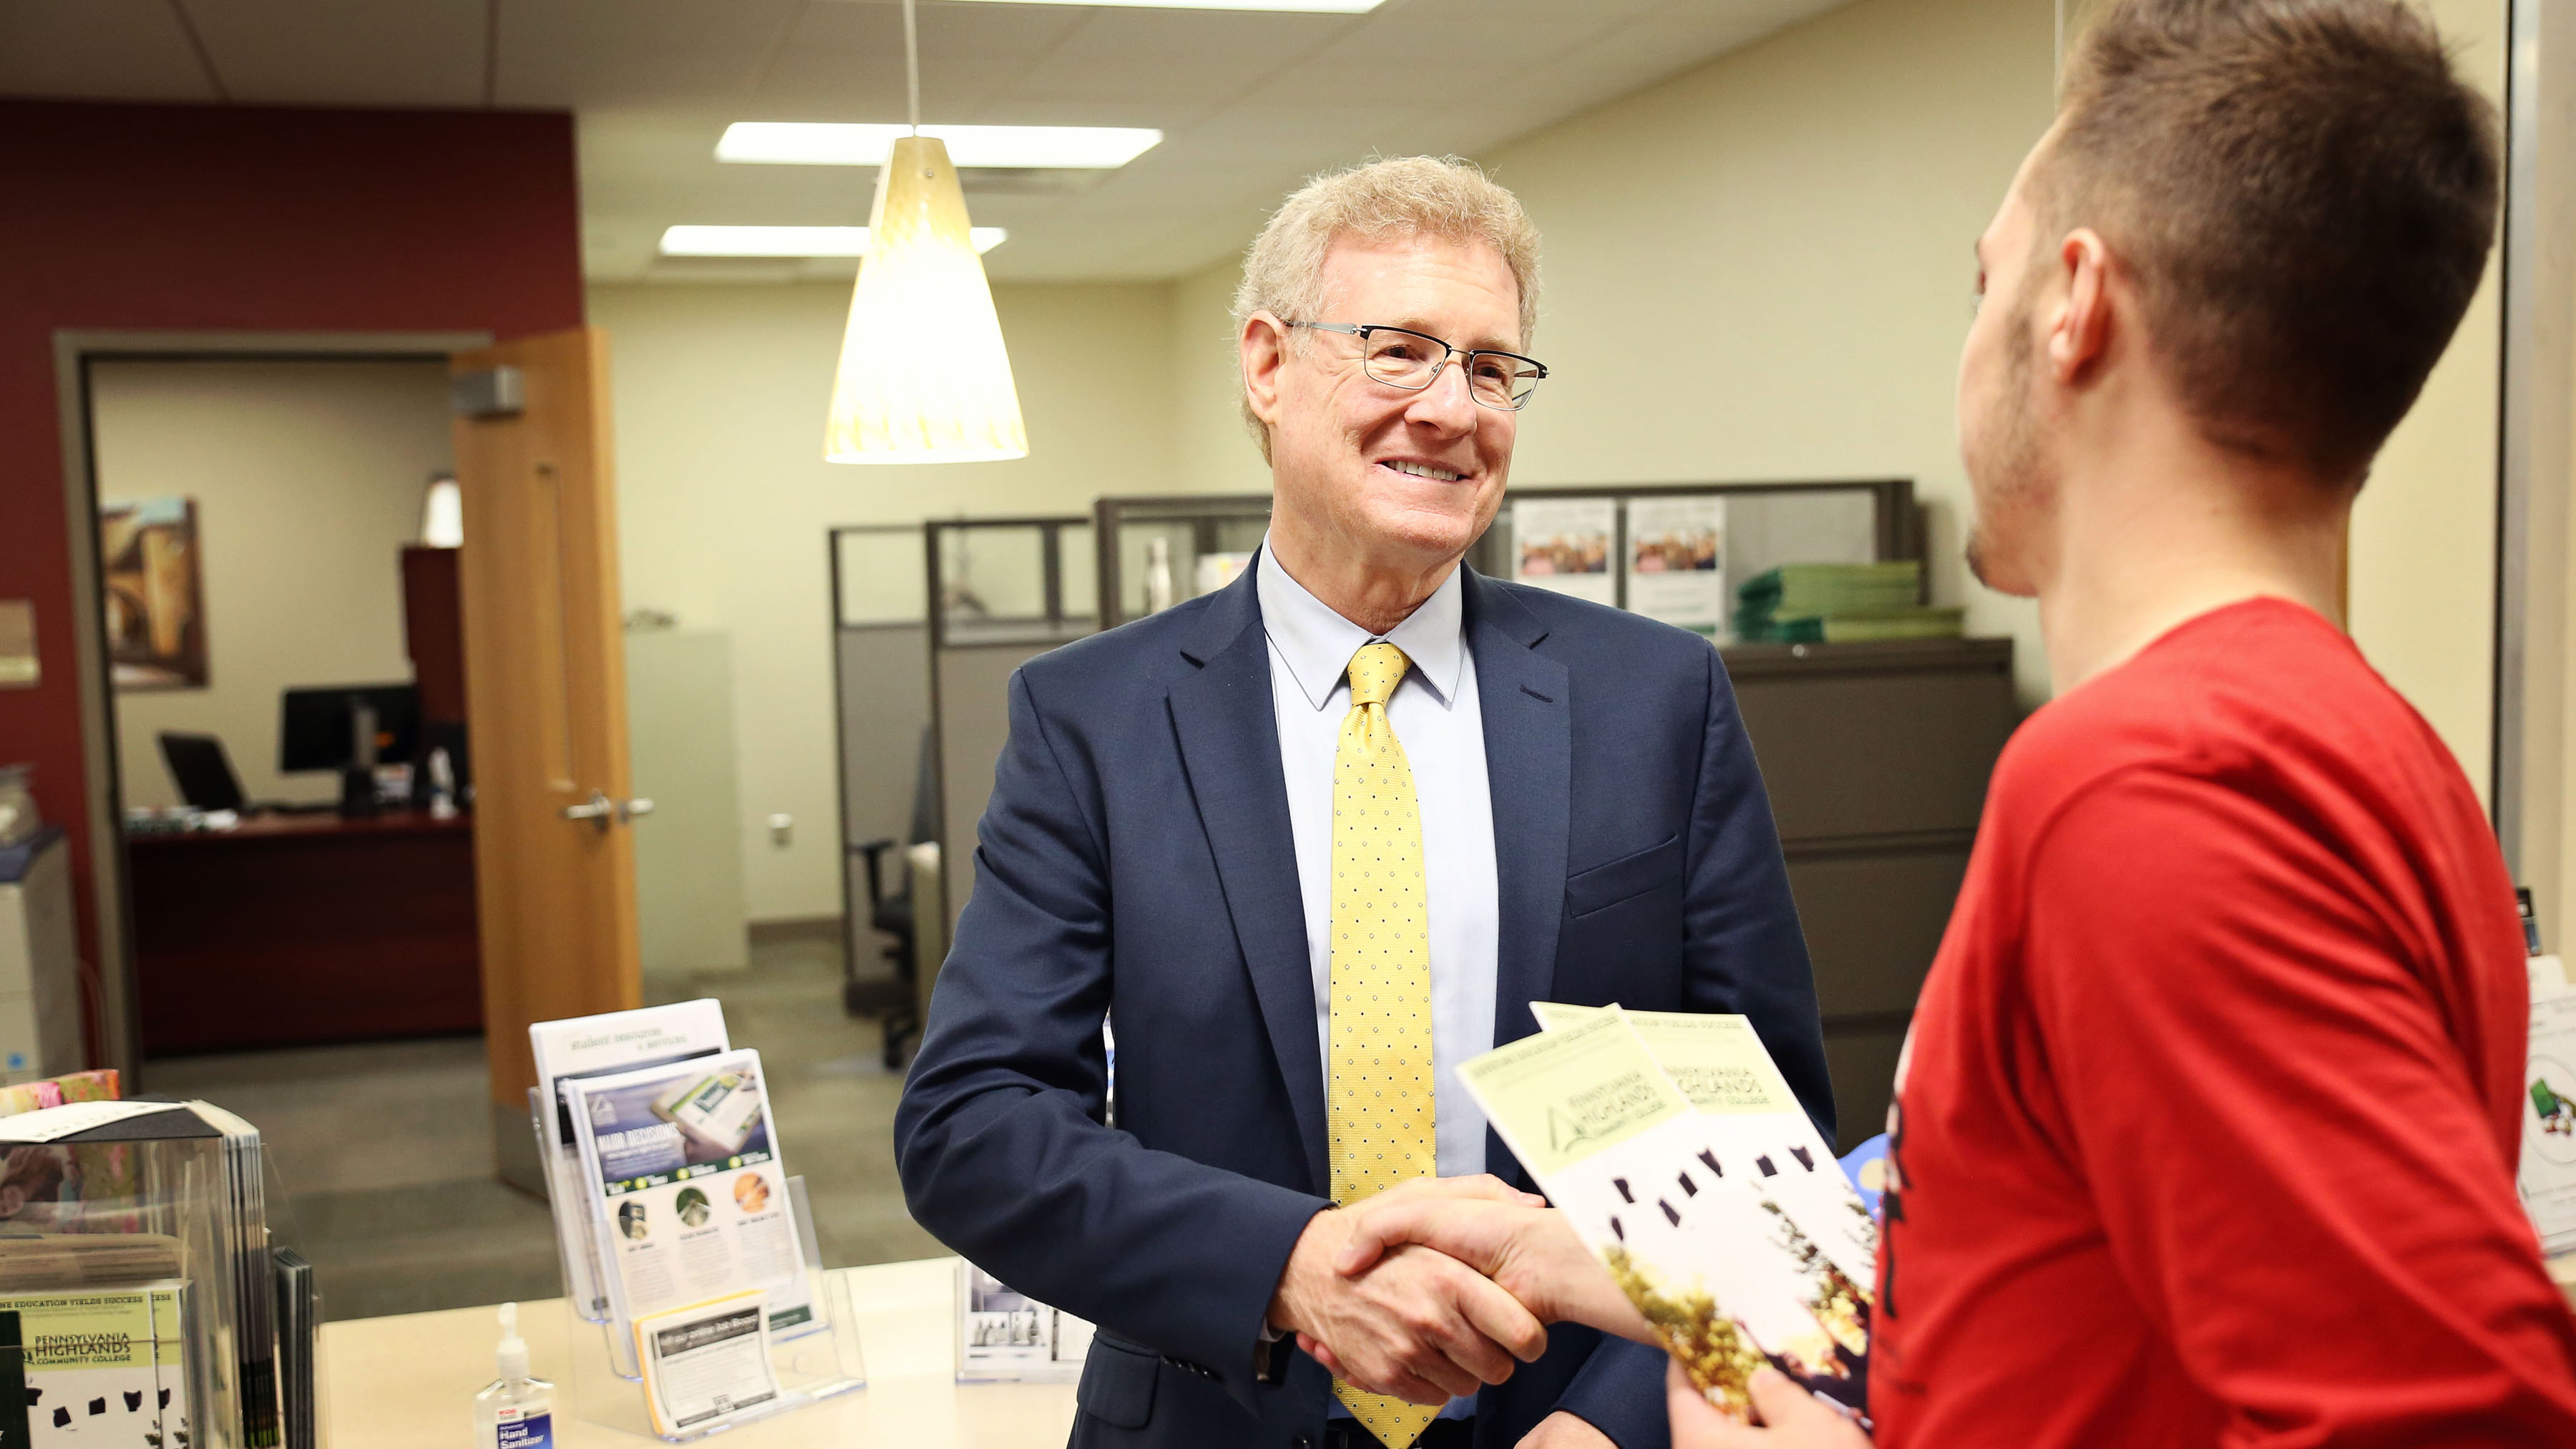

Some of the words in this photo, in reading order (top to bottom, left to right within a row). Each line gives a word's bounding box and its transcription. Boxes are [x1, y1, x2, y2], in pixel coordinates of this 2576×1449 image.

[625, 1122, 680, 1146] DECISIONS
[14, 1299, 67, 1308] EDUCATION
[71, 1297, 102, 1306] YIELDS
[34, 1332, 130, 1345] PENNSYLVANIA
[36, 1342, 131, 1357] HIGHLANDS
[36, 1357, 89, 1365] COMMUNITY
[92, 1354, 132, 1362] COLLEGE
[500, 1427, 529, 1440] Hand
[502, 1434, 545, 1449] Sanitizer
